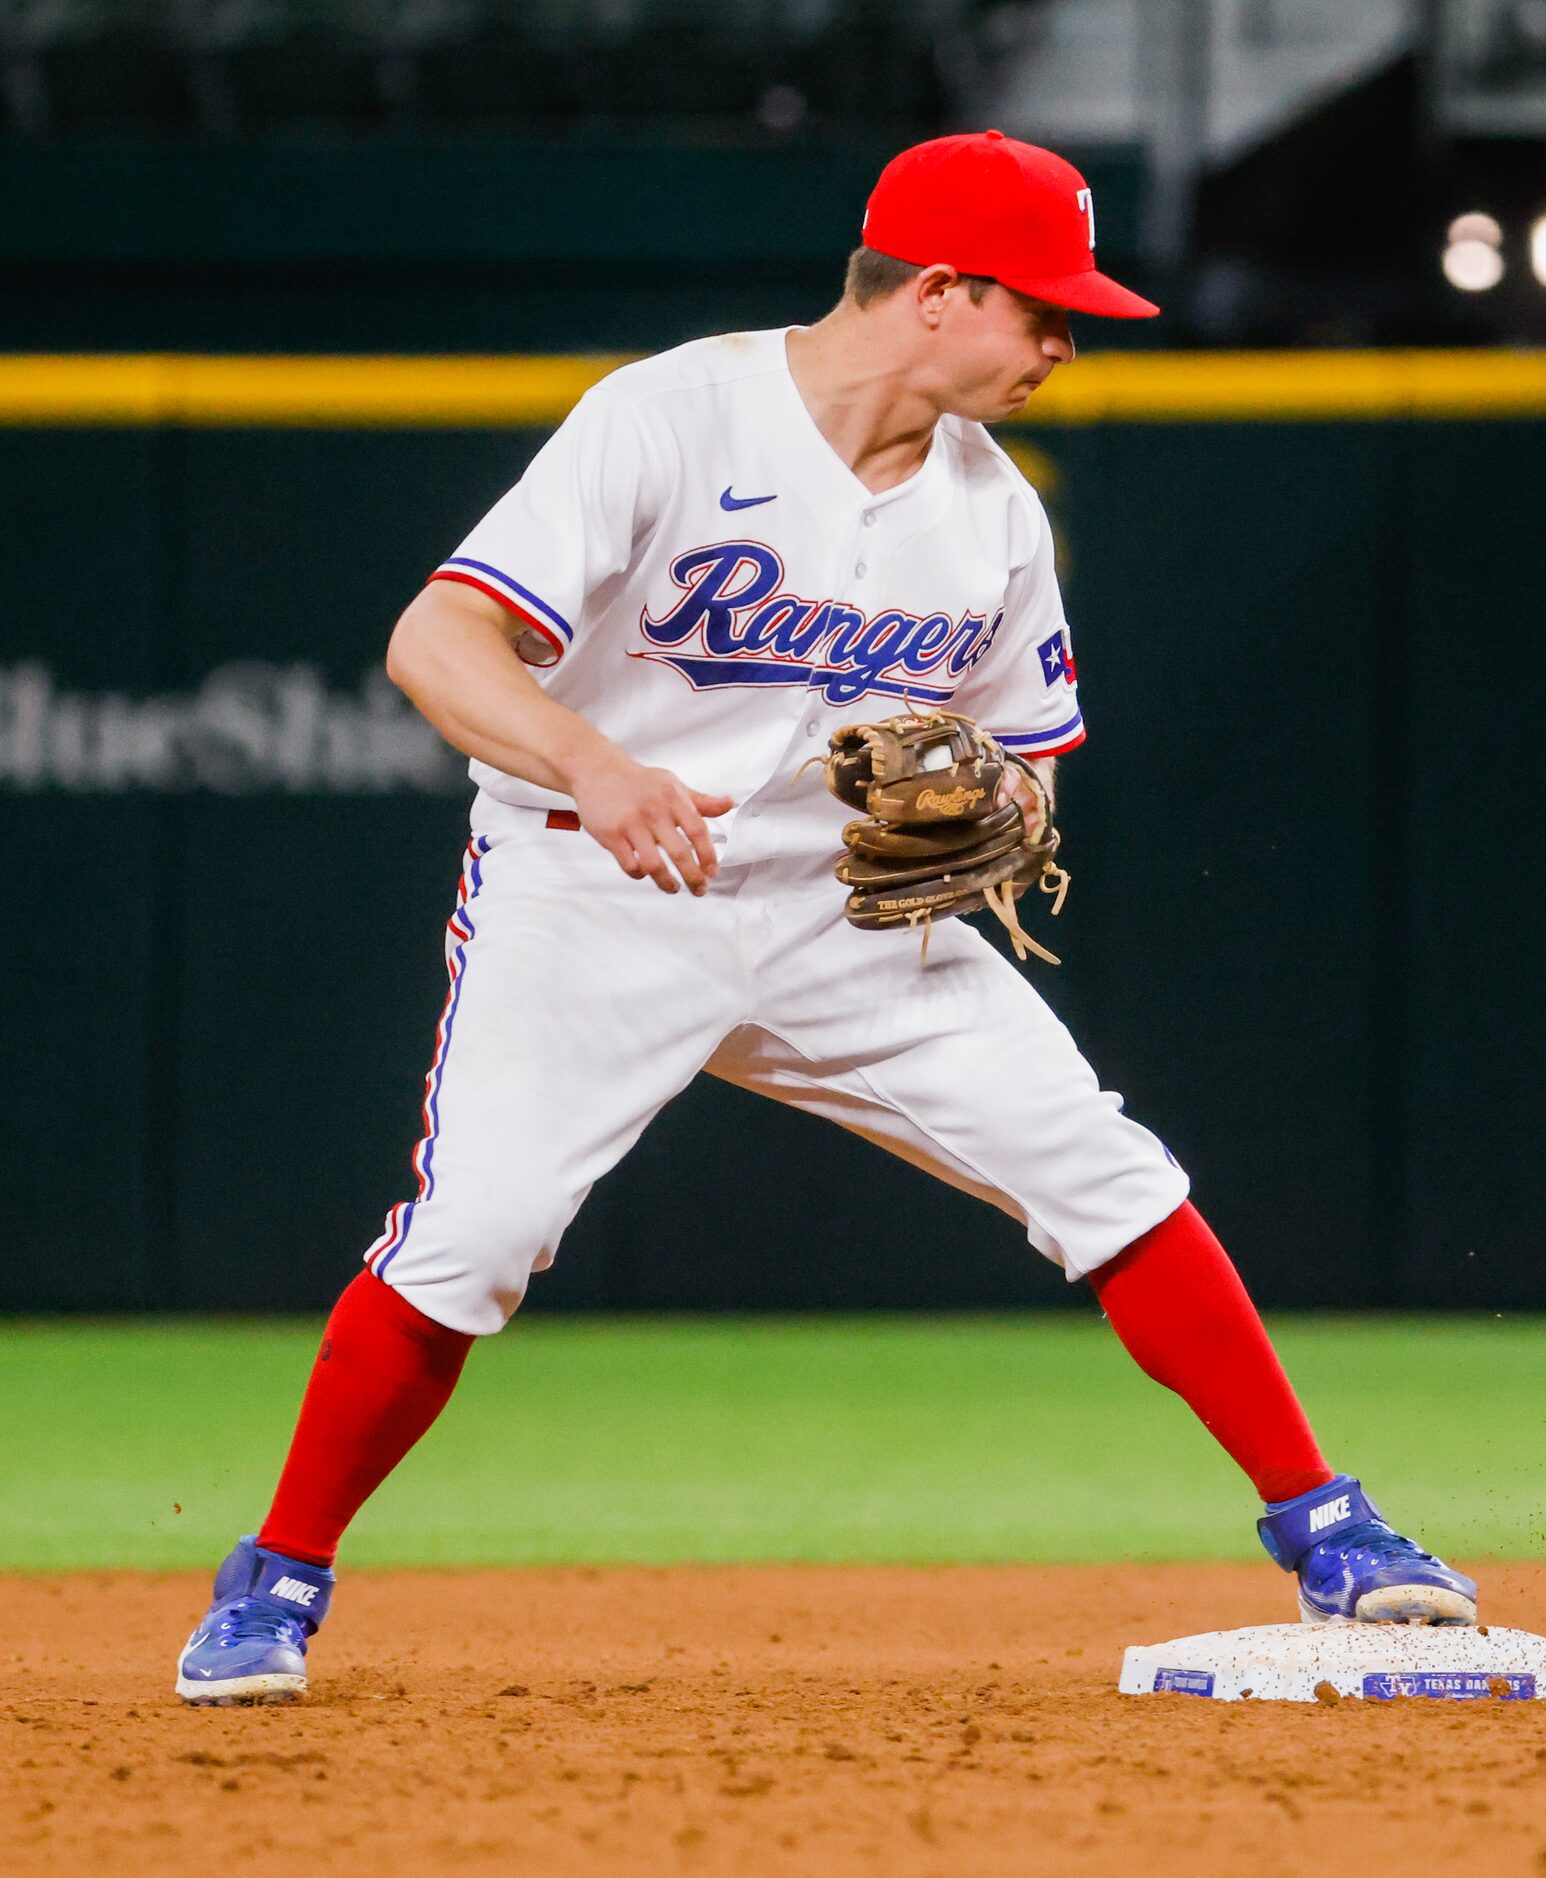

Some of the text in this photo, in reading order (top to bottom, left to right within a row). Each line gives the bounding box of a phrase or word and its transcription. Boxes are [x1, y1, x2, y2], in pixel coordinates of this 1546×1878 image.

[640, 539, 1005, 706] Rangers
[916, 786, 986, 813] Rawlings
[877, 900, 898, 910] THE
[898, 896, 925, 908] GOLD
[925, 891, 955, 904] GLOVE
[1309, 1494, 1351, 1533] NIKE
[269, 1576, 320, 1607] NIKE
[1424, 1678, 1461, 1690] TEXAS
